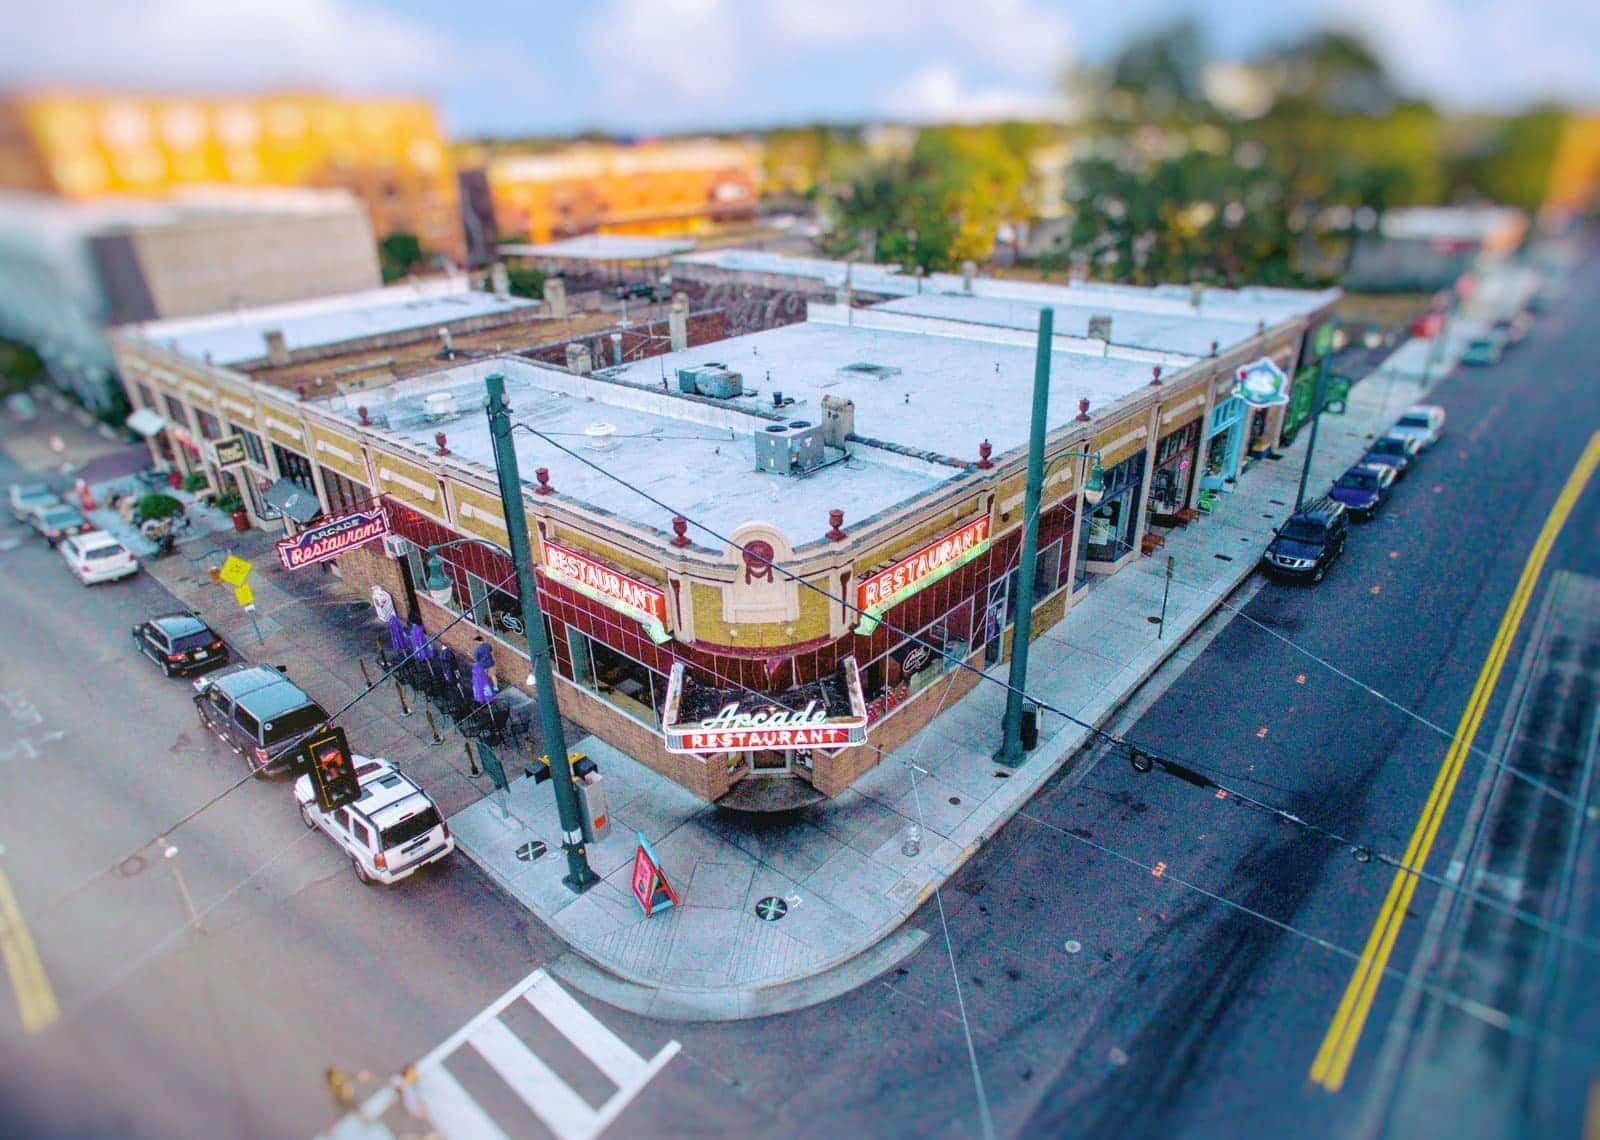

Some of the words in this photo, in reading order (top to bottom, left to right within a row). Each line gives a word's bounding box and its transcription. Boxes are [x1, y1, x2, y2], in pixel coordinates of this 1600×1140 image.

[290, 519, 383, 565] Restaurant
[310, 518, 360, 541] ARCADE
[546, 546, 660, 616] RESTAURANT
[866, 521, 986, 607] RESTAURANT
[701, 701, 827, 729] Arcade
[692, 730, 838, 748] RESTAURANT
